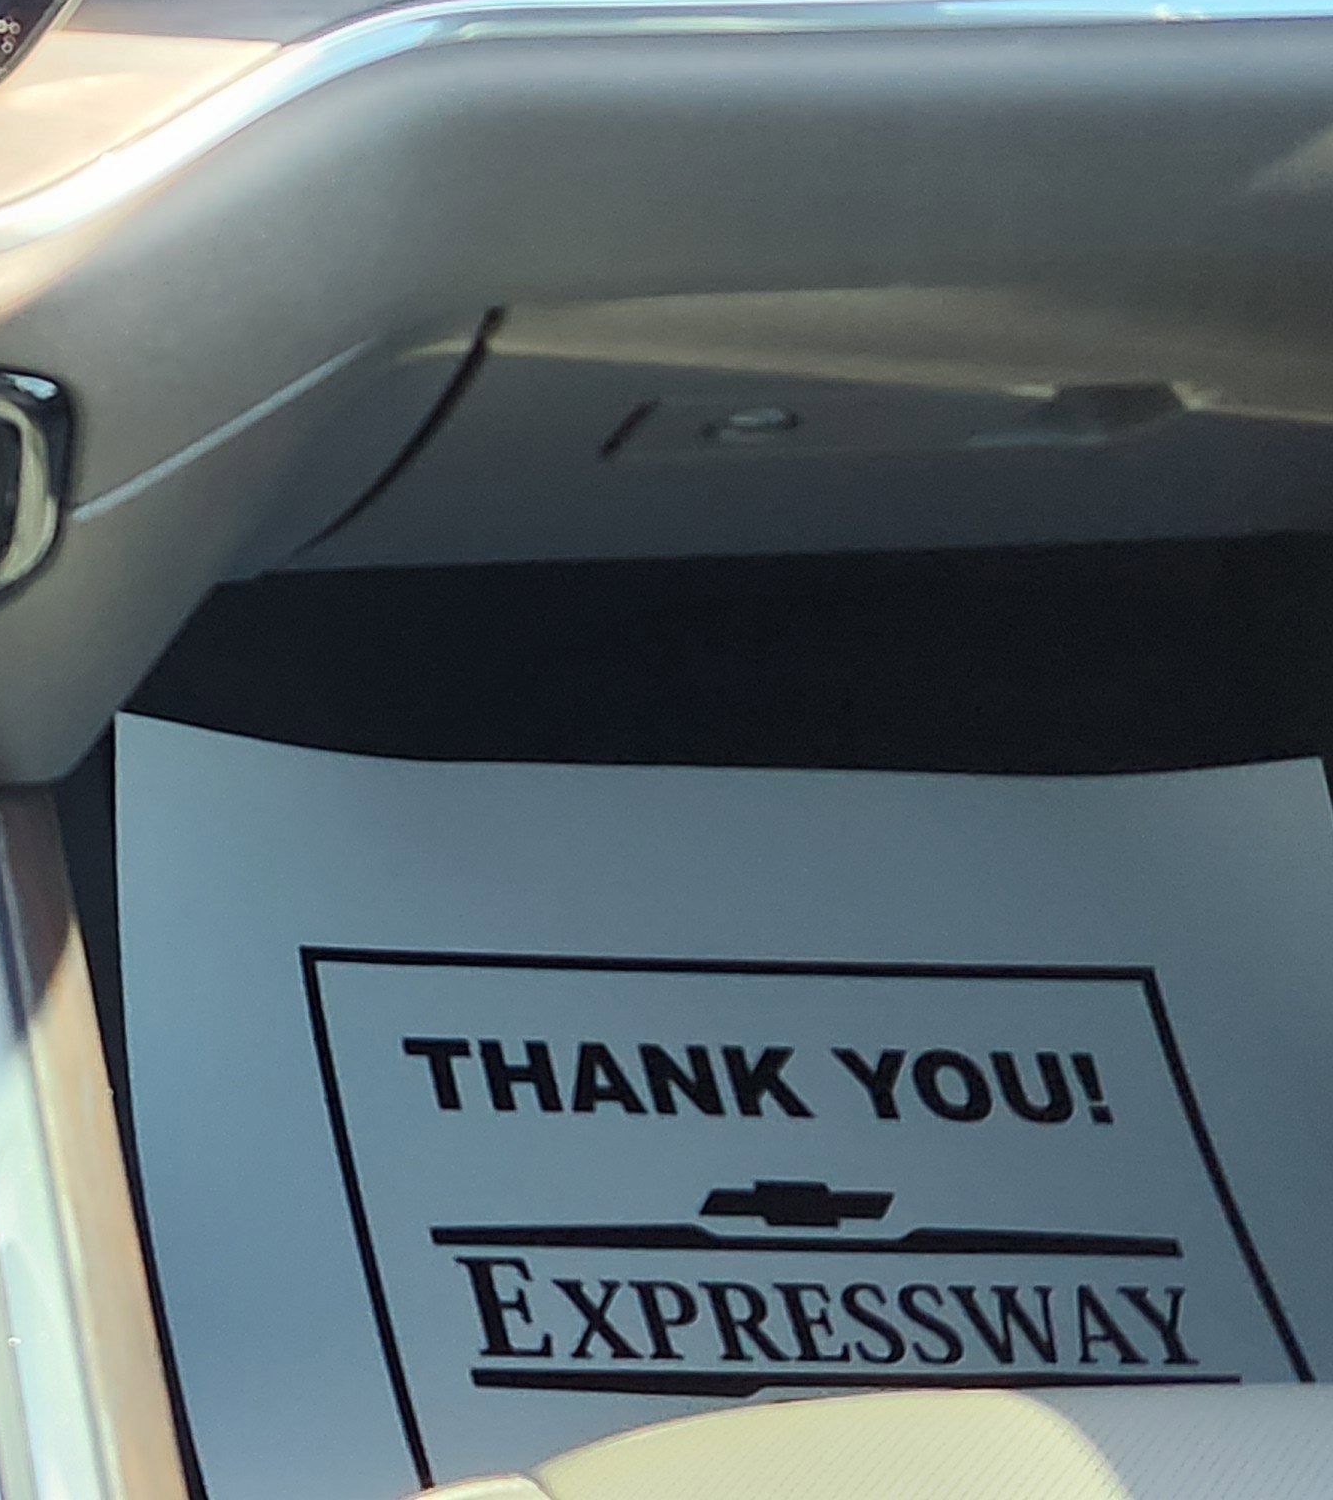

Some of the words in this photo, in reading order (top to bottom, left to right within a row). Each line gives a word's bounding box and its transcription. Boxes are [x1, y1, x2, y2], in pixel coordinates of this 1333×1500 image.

[403, 1036, 816, 1118] THANK
[833, 1048, 1114, 1124] YOU!
[454, 1256, 1199, 1365] EXPRESSWAY
